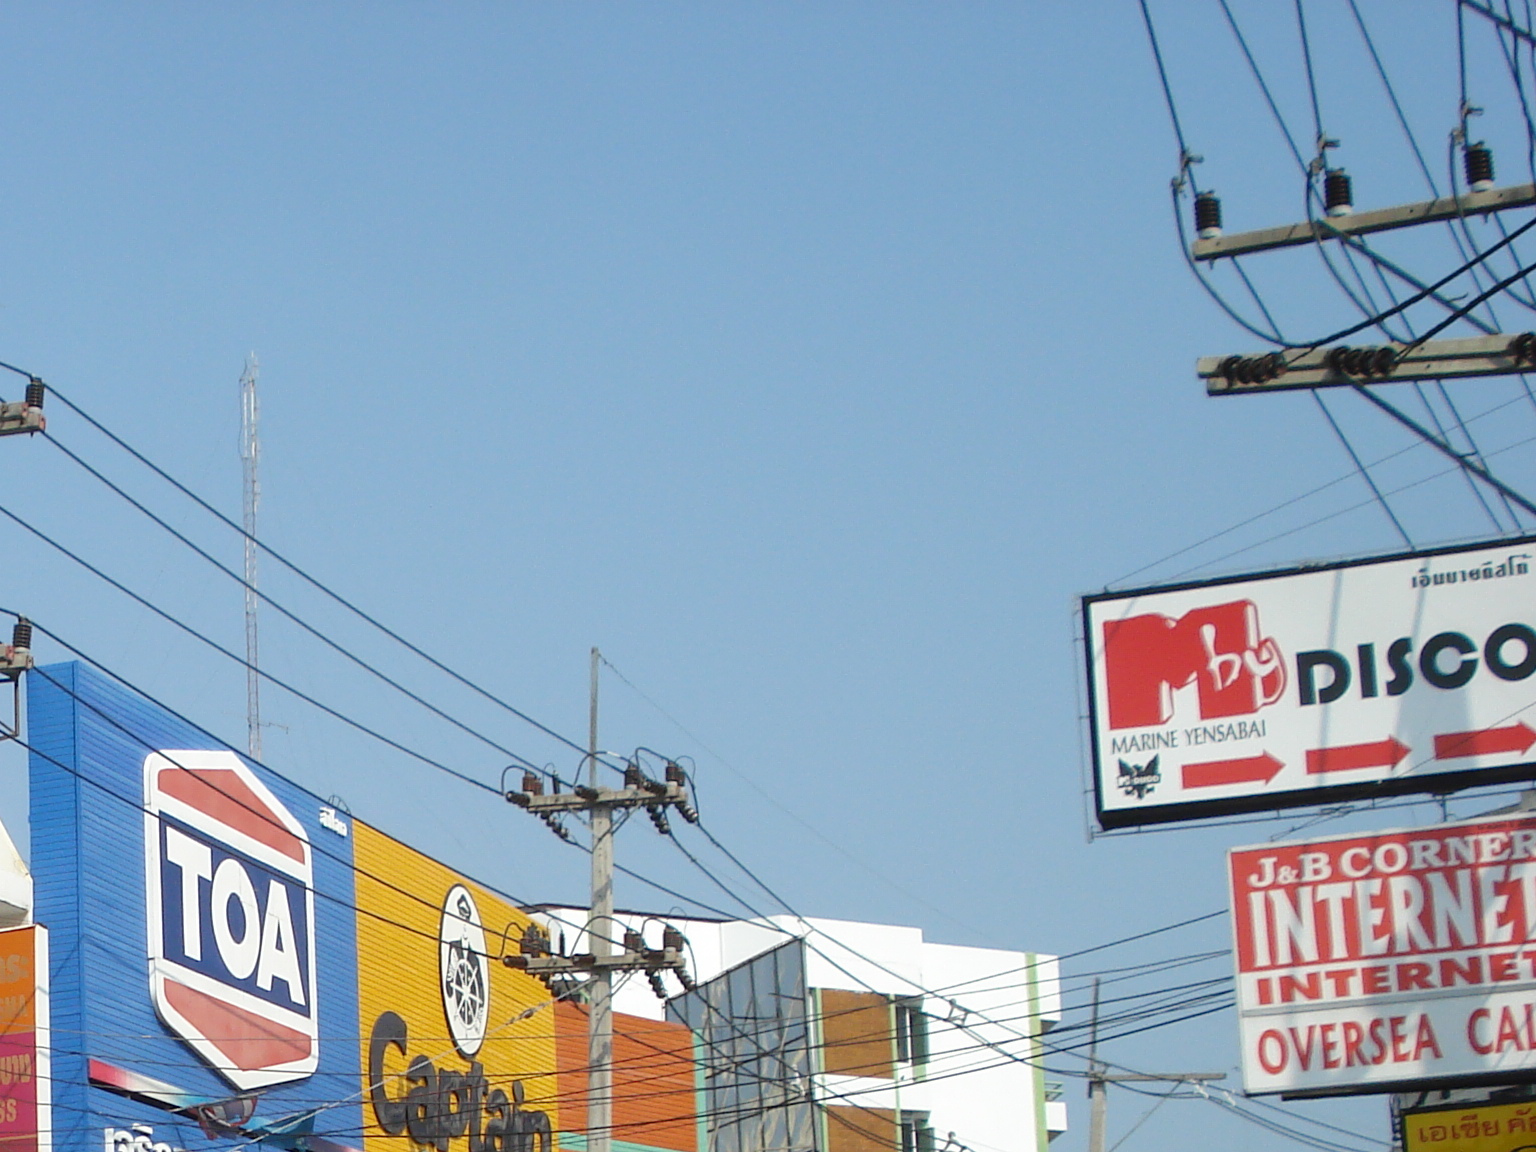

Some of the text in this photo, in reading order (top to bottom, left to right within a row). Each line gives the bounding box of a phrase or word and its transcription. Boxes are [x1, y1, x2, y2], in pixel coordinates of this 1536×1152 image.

[1296, 622, 1536, 706] DISCO
[1111, 719, 1266, 755] MARINE YENSABAI
[1248, 852, 1333, 888] J&B
[166, 824, 306, 1007] TOA
[1258, 1012, 1444, 1076] OVERSEA
